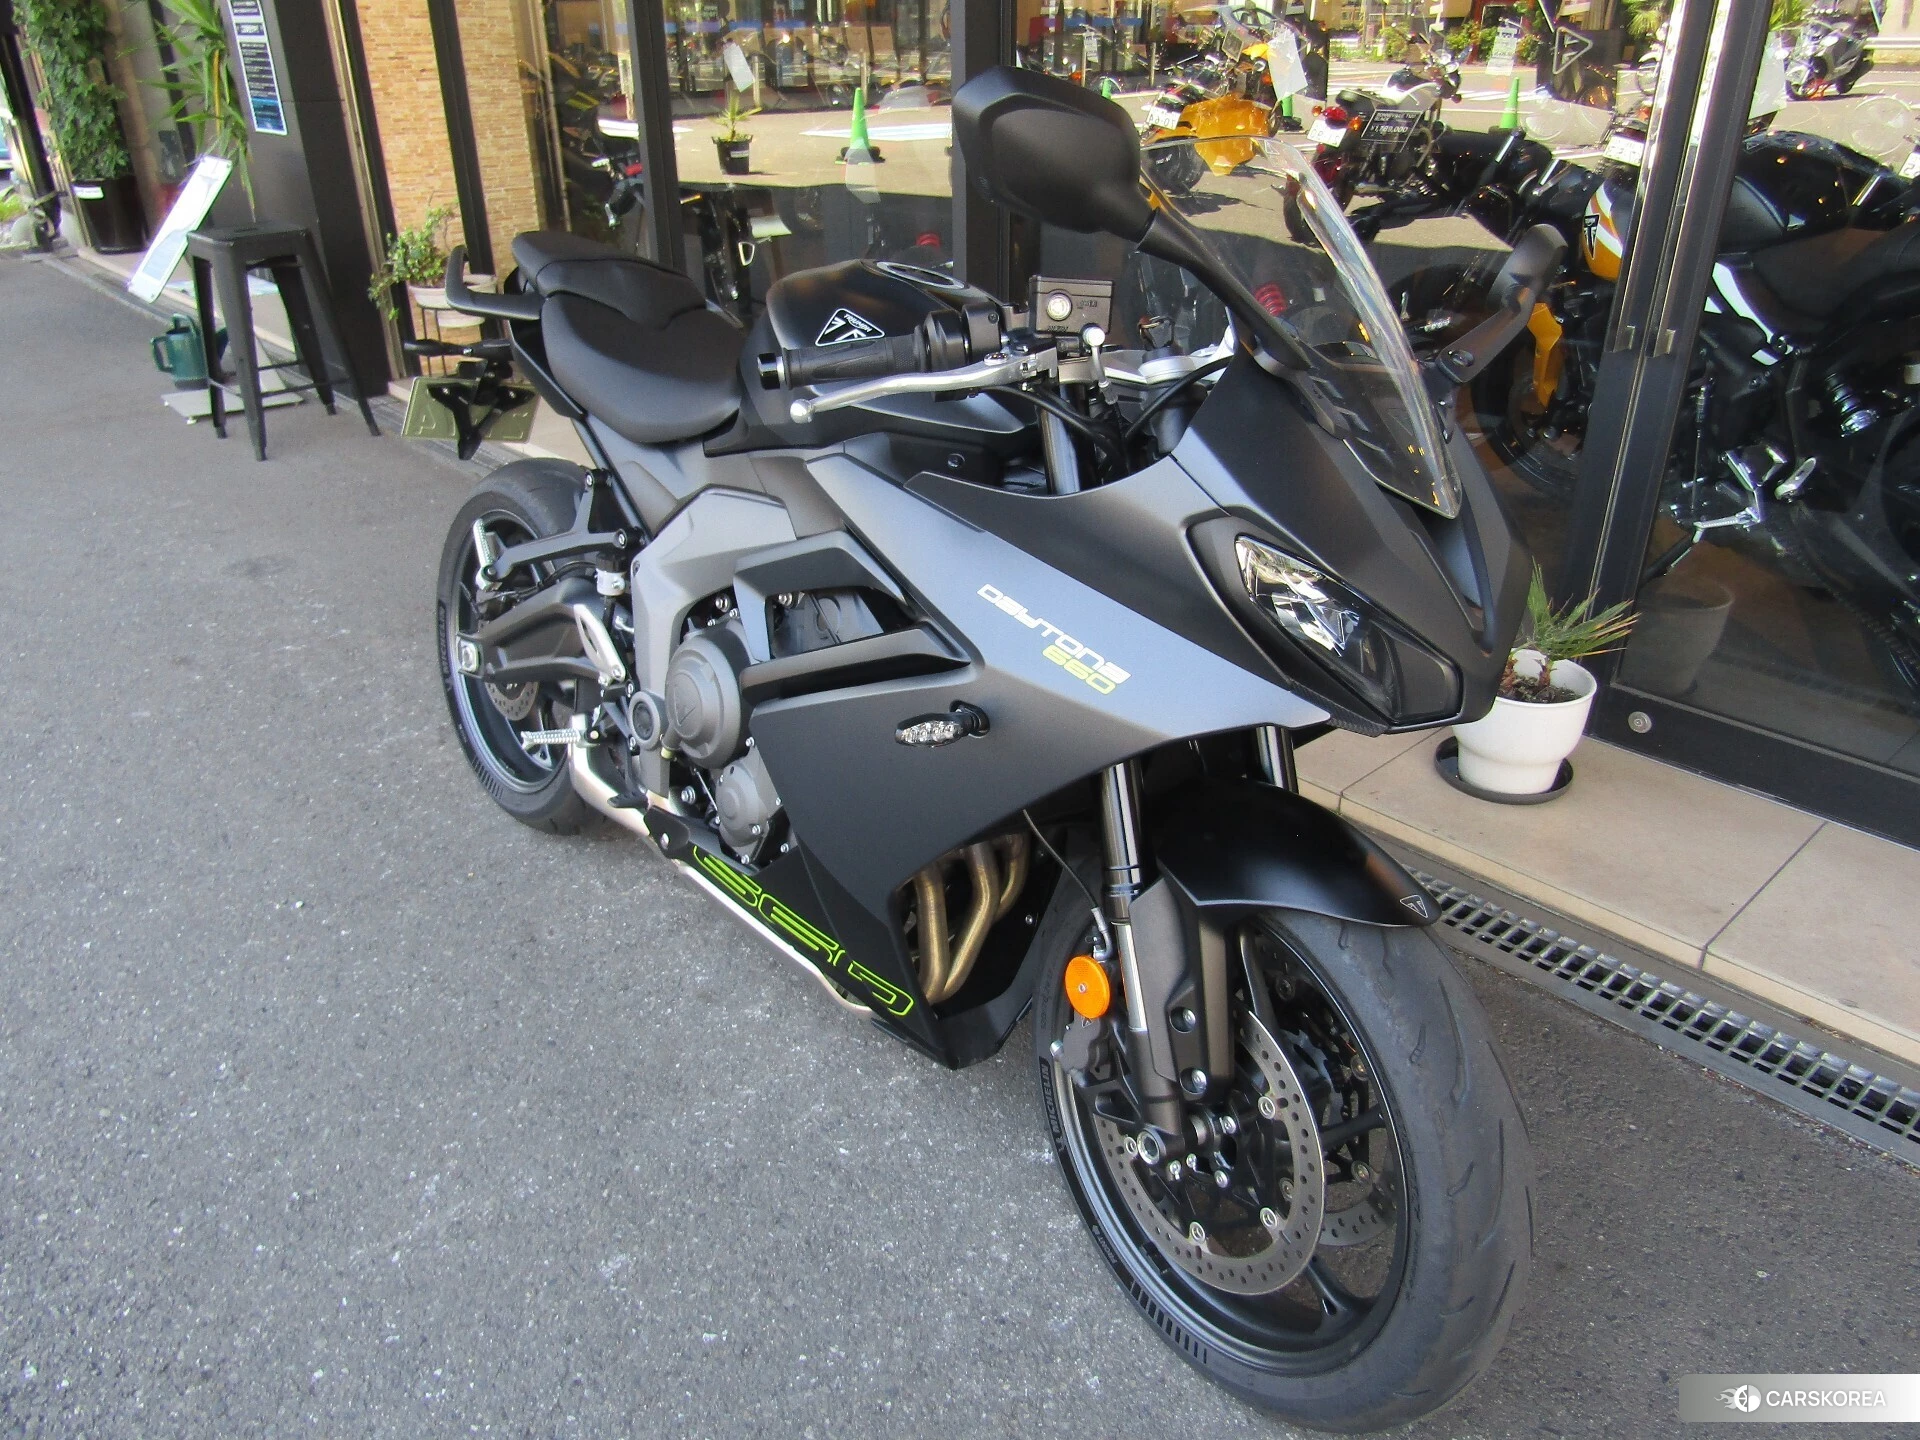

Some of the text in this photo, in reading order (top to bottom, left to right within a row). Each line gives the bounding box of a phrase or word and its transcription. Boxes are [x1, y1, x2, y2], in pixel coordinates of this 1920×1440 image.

[844, 313, 873, 332] TRIUMPH
[1042, 644, 1116, 695] 660
[1041, 1063, 1061, 1134] MICHELIN
